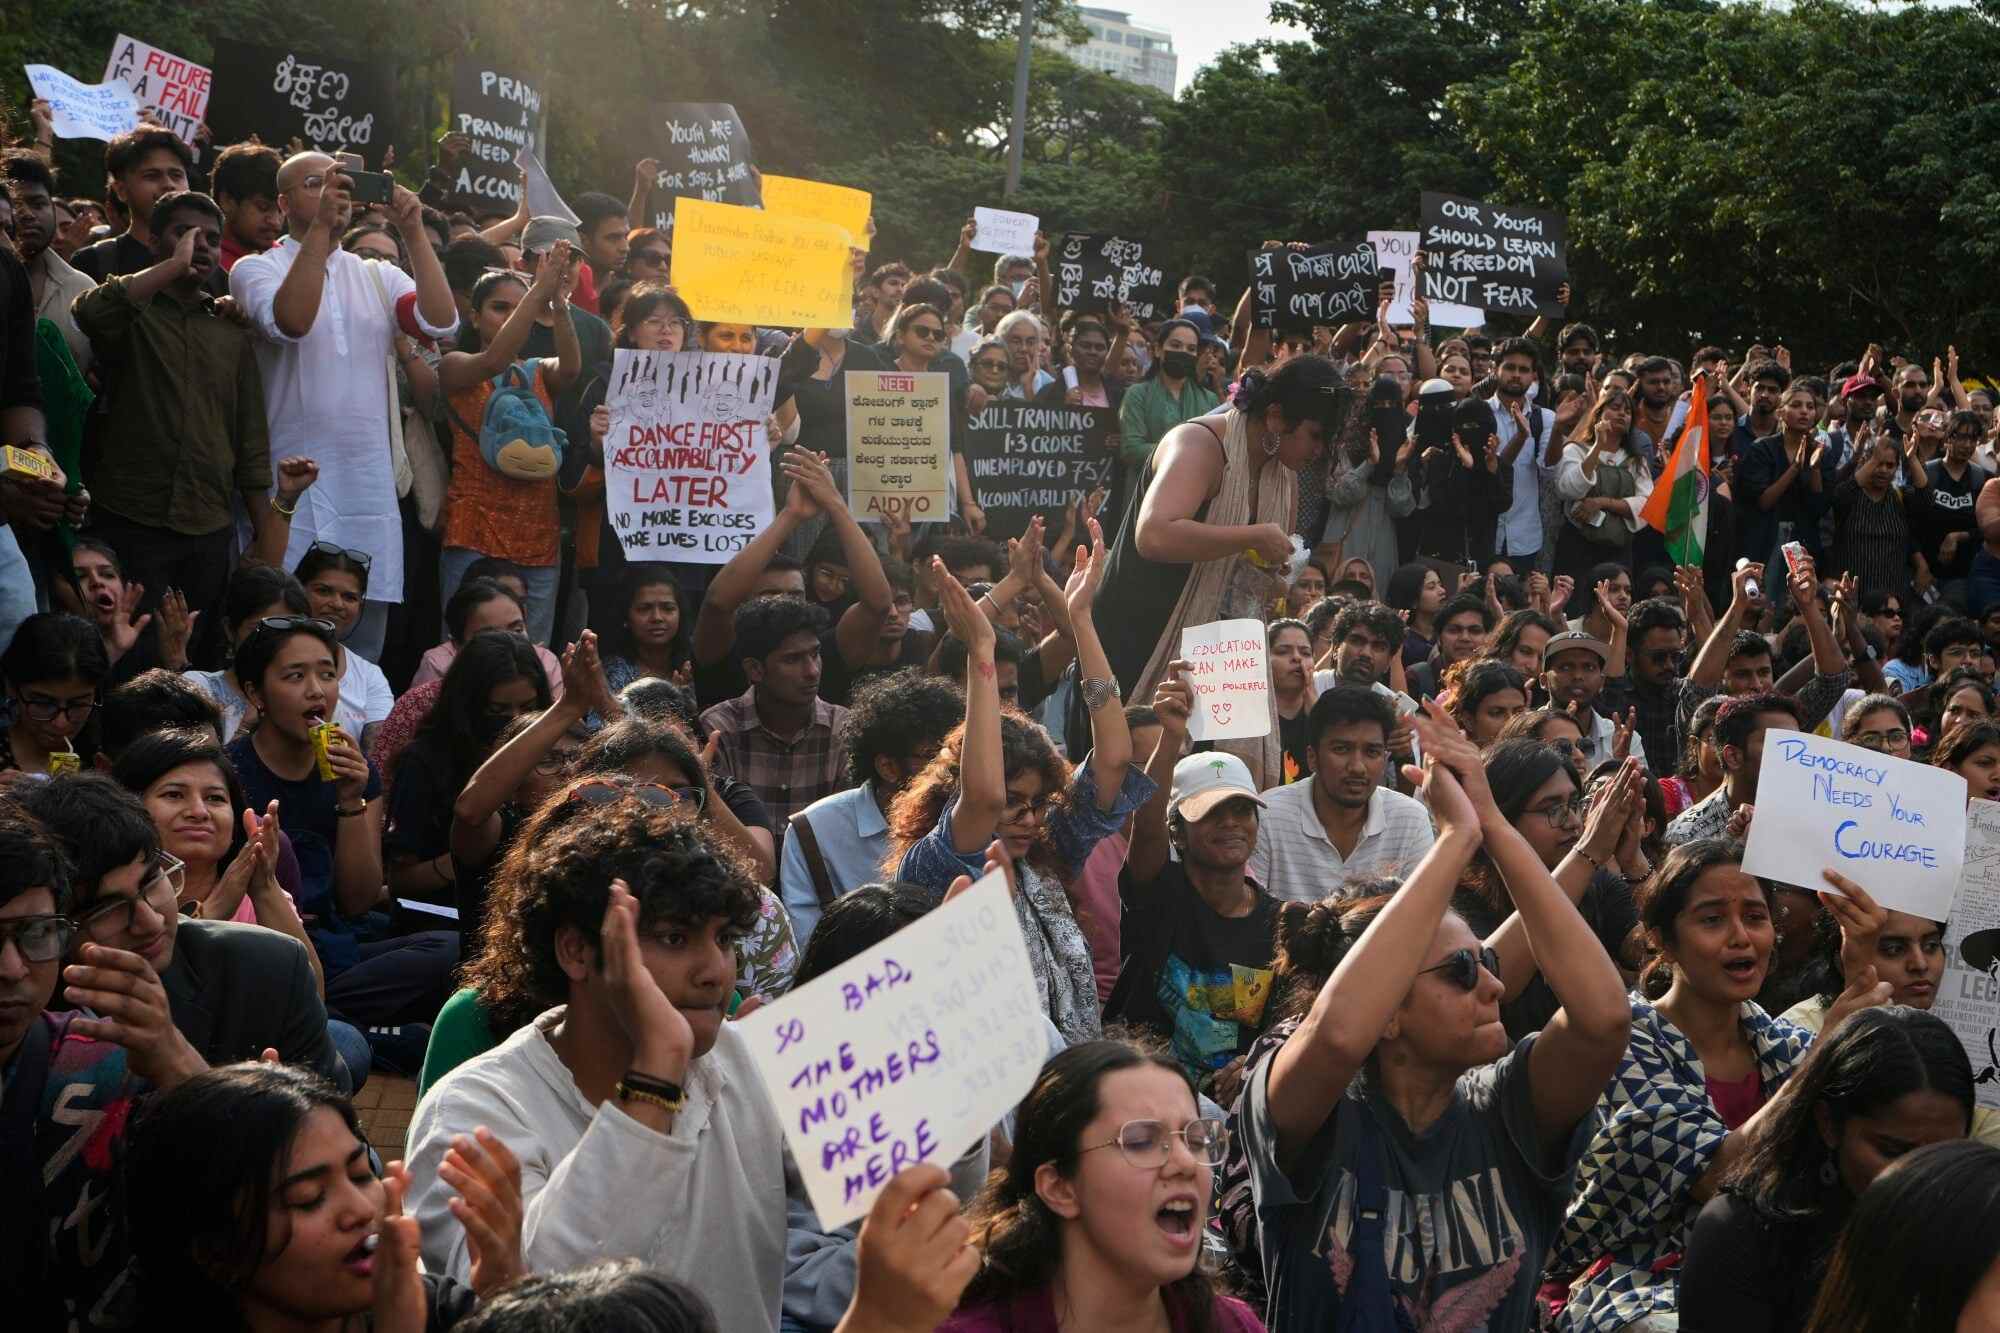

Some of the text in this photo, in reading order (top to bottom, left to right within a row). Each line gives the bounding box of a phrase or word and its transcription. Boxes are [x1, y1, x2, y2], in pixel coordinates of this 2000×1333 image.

[119, 42, 213, 93] A FUTURE
[133, 74, 148, 97] A
[159, 82, 203, 119] FAIL
[665, 119, 733, 144] YOUTH ARE
[471, 139, 510, 163] NEED
[657, 169, 684, 189] FOR
[688, 169, 714, 187] JOBS
[702, 186, 727, 202] NOT
[1441, 200, 1543, 236] OUR YOUTH
[1382, 237, 1411, 256] YOU
[1426, 225, 1556, 258] SHOULD LEARN
[1428, 249, 1536, 278] IN FREEDOM
[1424, 272, 1478, 302] NOT
[1482, 282, 1538, 309] FEAR
[878, 376, 914, 392] NEET
[967, 407, 1095, 431] SKILL TRAINING
[628, 420, 760, 451] DANCE FIRST
[1031, 435, 1084, 453] CRORE
[612, 447, 757, 474] ACCOUNTABILITY
[973, 457, 1113, 485] UNEMPLOYED 75%
[633, 476, 728, 508] LATER
[867, 495, 930, 513] AIDYO
[977, 487, 1086, 510] ACCOUNTABILITY
[615, 508, 756, 530] NO MORE EXCUSES
[657, 532, 698, 548] LIVES
[704, 533, 756, 552] LOST
[1192, 639, 1263, 656] EDUCATION
[1223, 657, 1259, 673] MAKE
[1193, 680, 1268, 696] YOU POWERFUL
[776, 958, 913, 1053] SO BAD,
[789, 1042, 857, 1090] THE
[799, 1029, 941, 1135] MOTHERS
[821, 1111, 892, 1172] ARE
[843, 1118, 941, 1203] HERE
